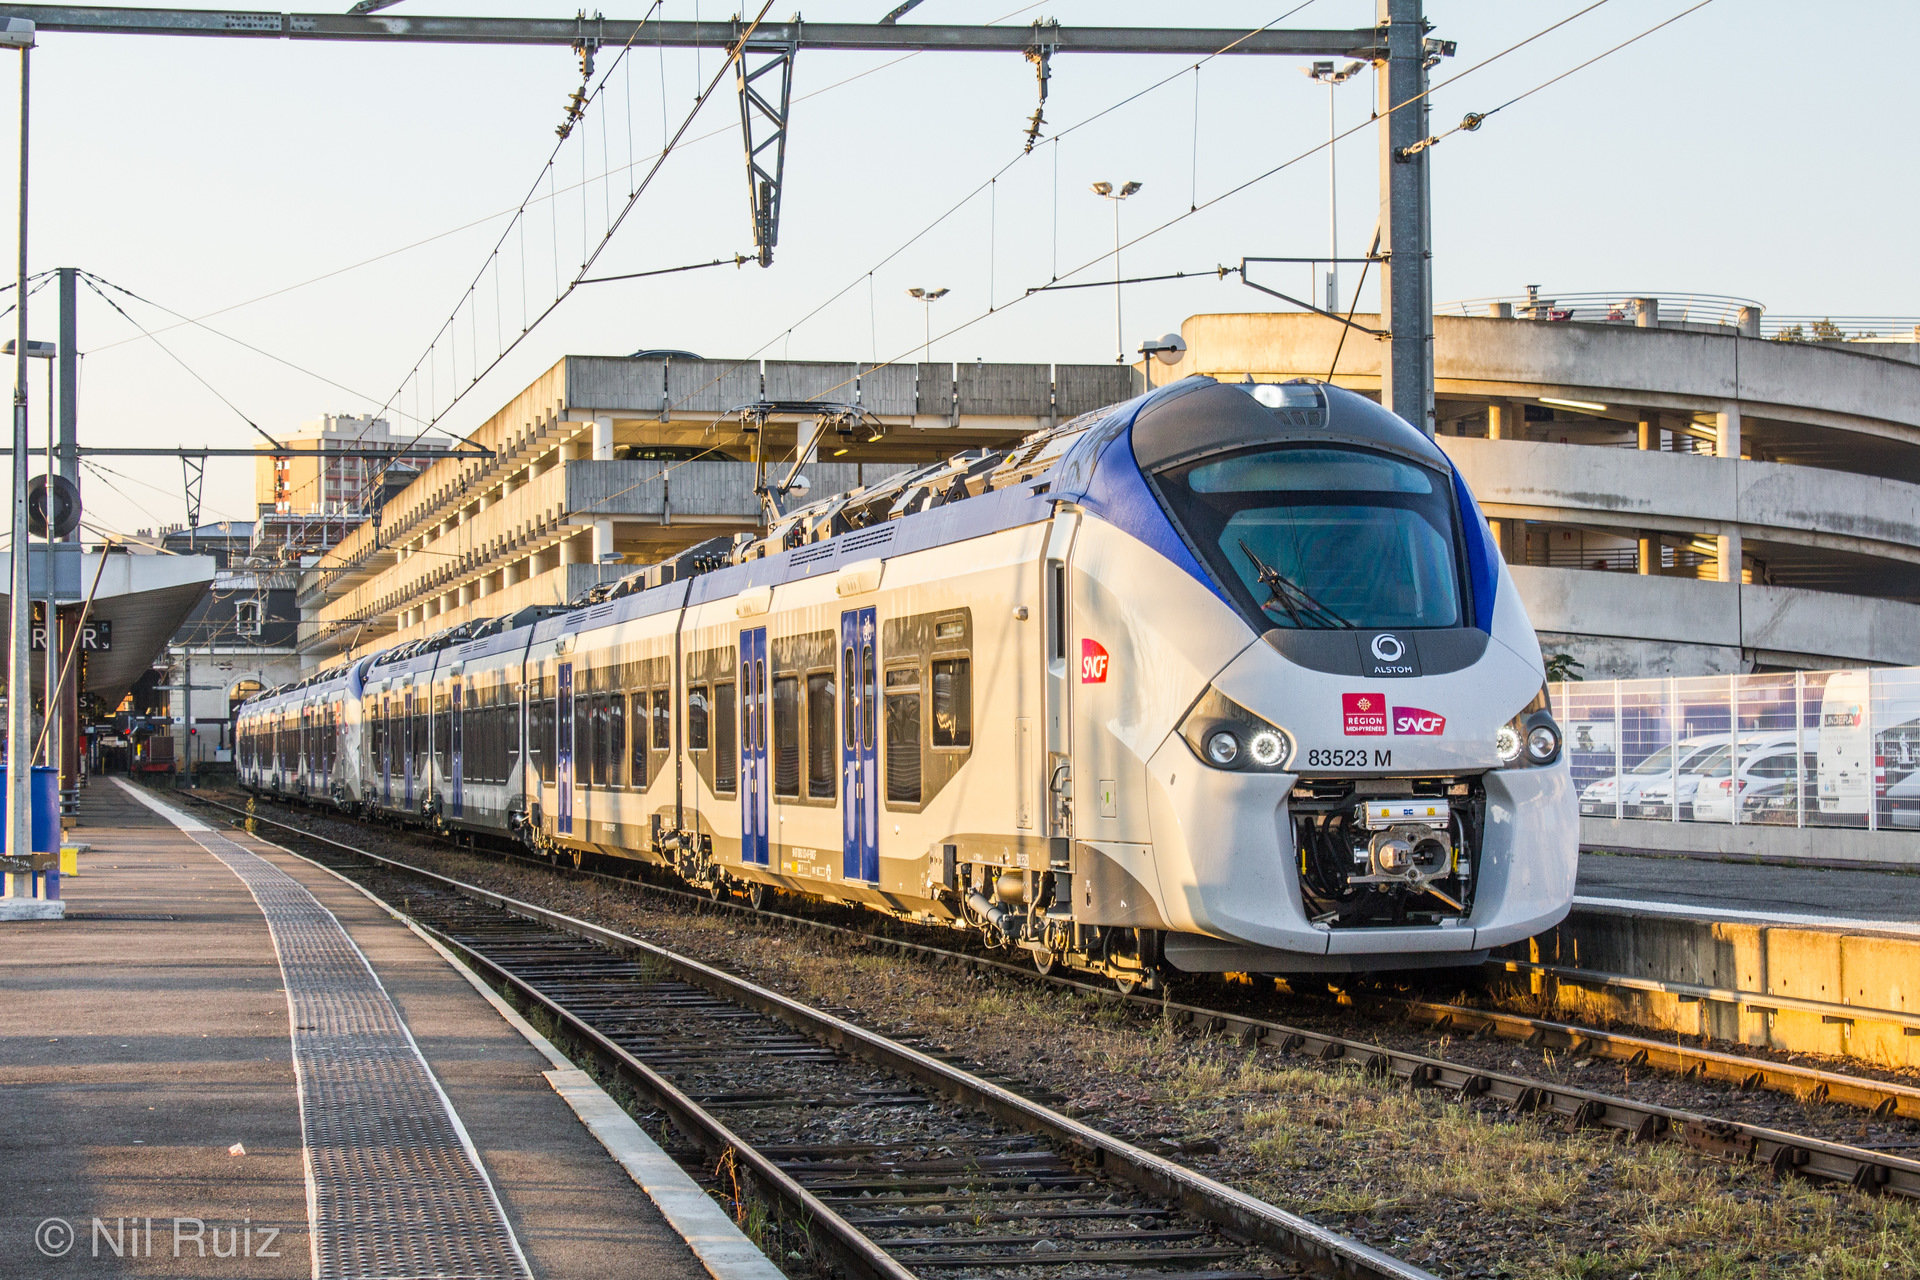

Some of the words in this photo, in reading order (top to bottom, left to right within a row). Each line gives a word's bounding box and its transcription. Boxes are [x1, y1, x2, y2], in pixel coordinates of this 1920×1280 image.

[82, 628, 98, 649] R
[1083, 656, 1107, 678] SNCF
[1374, 666, 1413, 674] ALSTOM
[1348, 716, 1382, 725] RÉGION
[1396, 717, 1443, 732] SNCF
[1308, 749, 1368, 767] 83523
[1374, 749, 1392, 767] M
